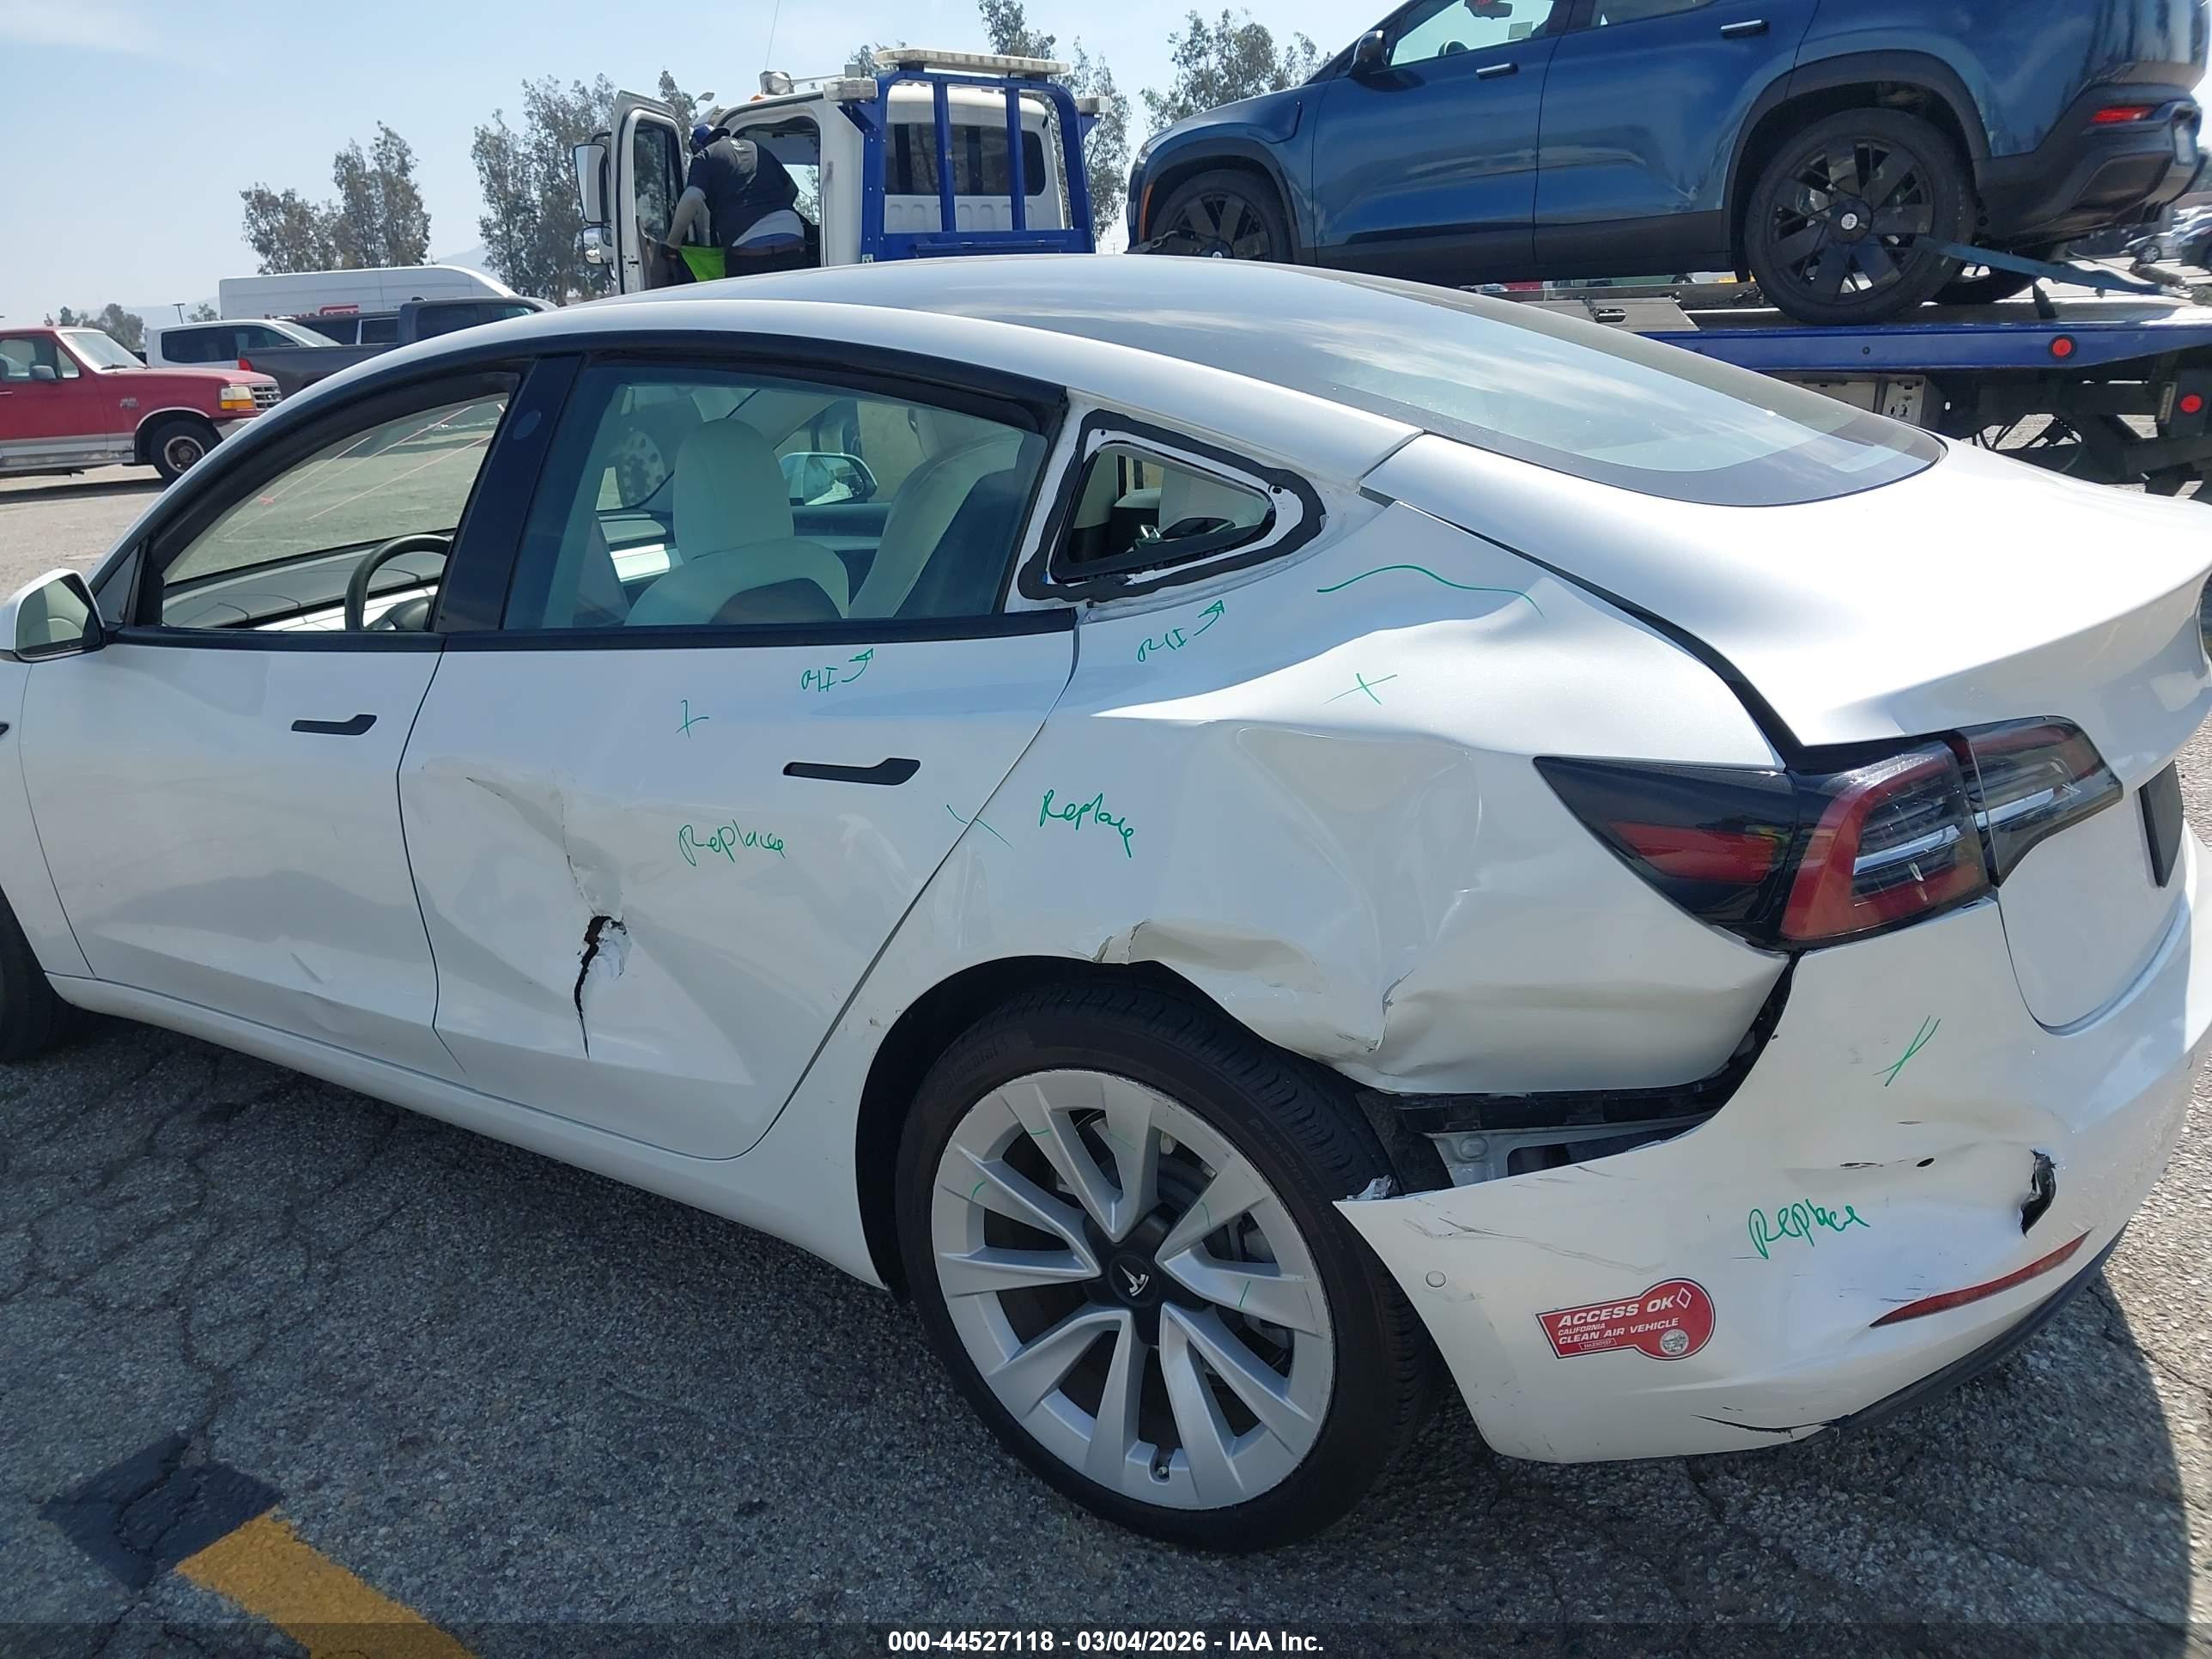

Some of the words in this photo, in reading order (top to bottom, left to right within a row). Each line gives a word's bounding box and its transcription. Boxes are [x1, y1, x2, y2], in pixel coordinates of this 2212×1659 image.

[1558, 1304, 1639, 1328] ACCESS
[1646, 1294, 1675, 1313] OK
[1558, 1323, 1606, 1336] CALIFORNIA
[1559, 1332, 1600, 1345] CLEAN
[1603, 1328, 1626, 1339] AIR
[1630, 1317, 1680, 1334] VEHICLE
